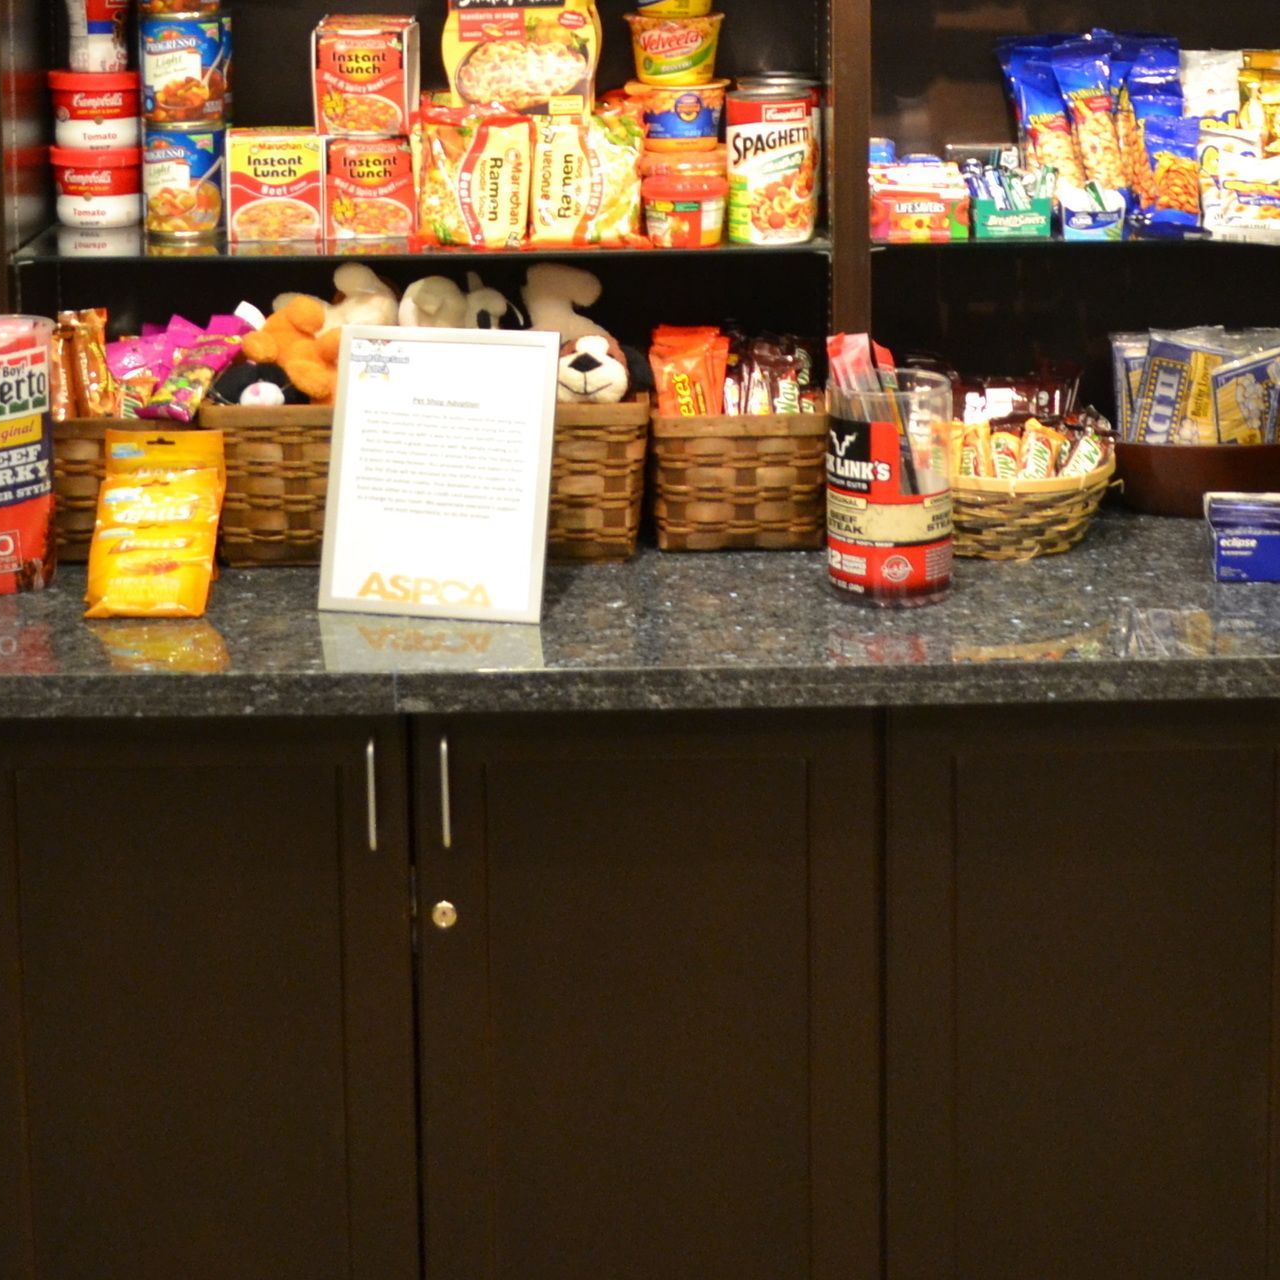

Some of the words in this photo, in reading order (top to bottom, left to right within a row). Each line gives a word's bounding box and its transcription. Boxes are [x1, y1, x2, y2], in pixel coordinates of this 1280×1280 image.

[145, 37, 196, 55] PROGRESSO
[638, 29, 702, 54] Velveeta
[332, 52, 387, 64] Instant
[338, 63, 381, 74] Lunch
[71, 91, 125, 108] Campbell's
[81, 131, 119, 141] Tomato
[258, 142, 303, 151] Maruchan
[246, 155, 303, 168] Instant
[343, 156, 398, 168] Instant
[63, 168, 113, 185] Campbell's
[252, 167, 297, 179] Lunch
[349, 167, 392, 179] Lunch
[260, 183, 288, 196] Beef
[488, 156, 504, 222] Ramen
[557, 153, 574, 219] Ramen
[72, 207, 108, 218] Tomato
[2, 362, 26, 380] Boy!
[775, 380, 801, 414] Way
[837, 457, 891, 482] LINK'S
[15, 481, 53, 500] STYLE
[1219, 537, 1258, 549] eclipse
[356, 571, 493, 608] ASPCA
